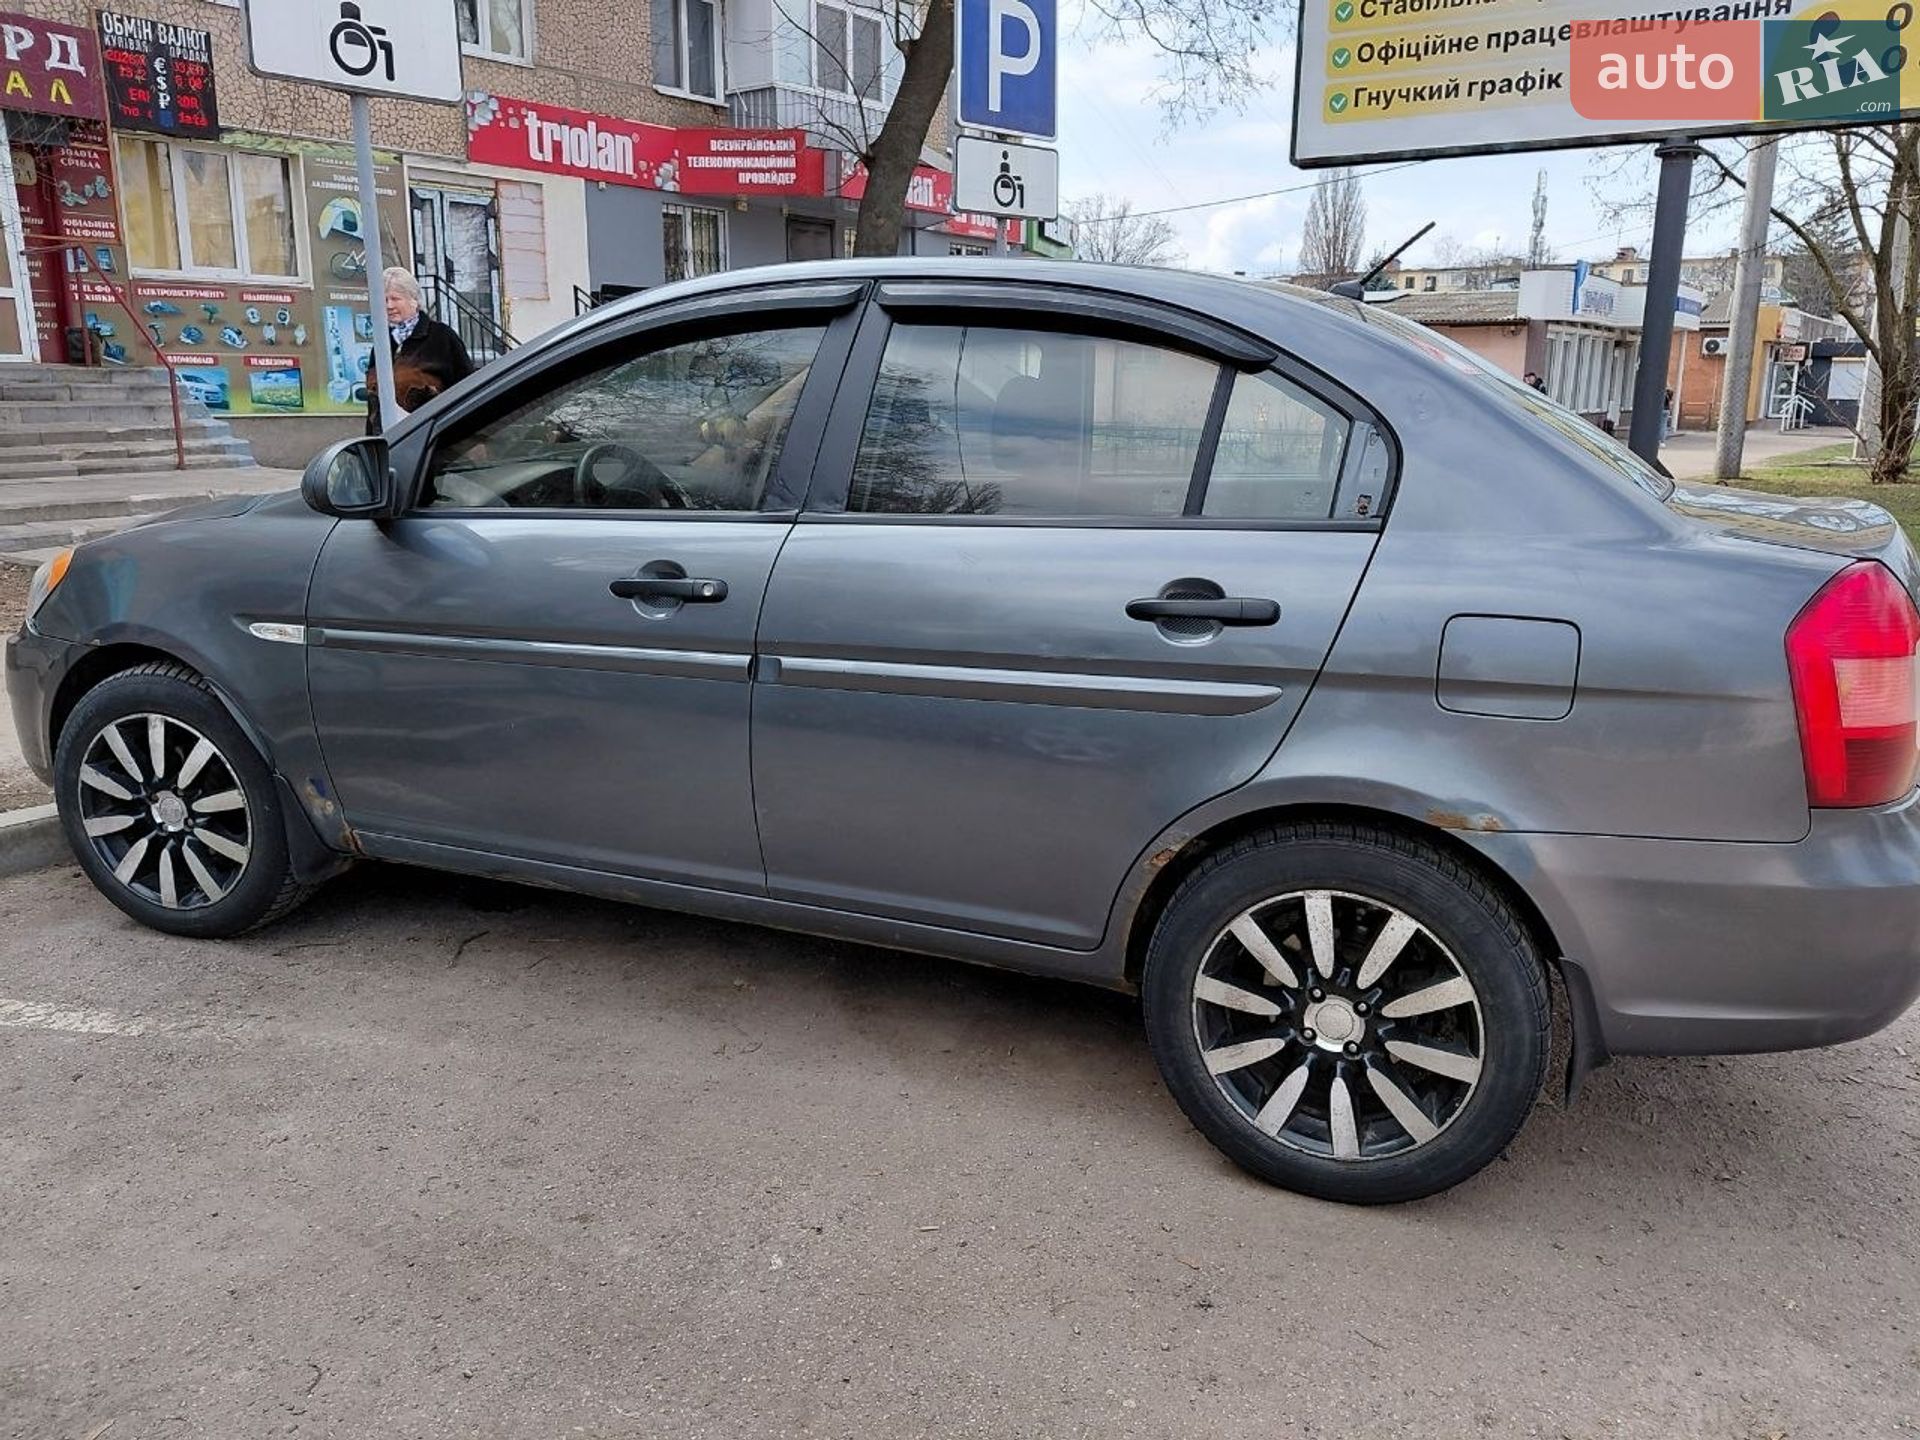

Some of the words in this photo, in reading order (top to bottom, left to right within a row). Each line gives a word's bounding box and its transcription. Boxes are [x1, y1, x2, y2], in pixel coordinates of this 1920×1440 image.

[102, 12, 152, 41] ОБМІН
[157, 24, 206, 51] ВАЛЮТ
[1357, 34, 1479, 65] Офіційне
[1486, 0, 1793, 53] працевлаштування
[1353, 80, 1460, 110] Гнучкий
[1467, 68, 1565, 101] графік
[525, 111, 634, 176] triolan
[737, 170, 797, 186] ПРОВАЙДЕР
